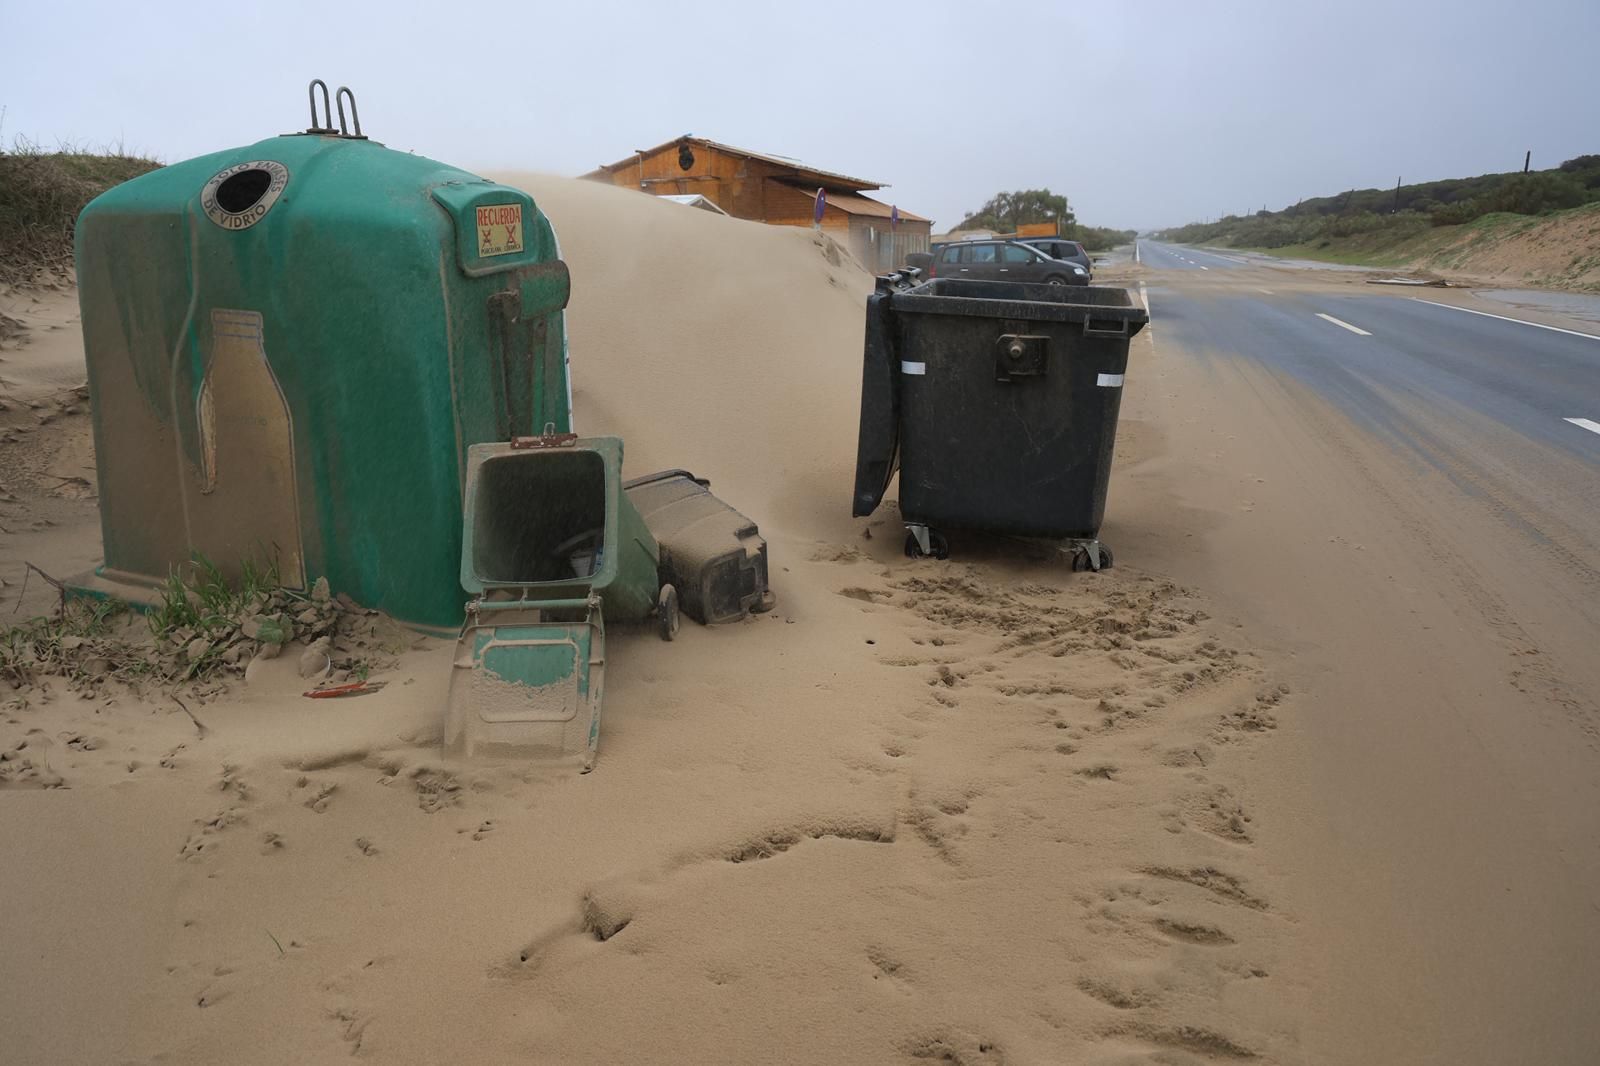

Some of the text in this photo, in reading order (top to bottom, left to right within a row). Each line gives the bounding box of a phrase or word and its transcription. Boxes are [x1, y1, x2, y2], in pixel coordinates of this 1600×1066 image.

[210, 163, 249, 186] SOLO
[204, 199, 266, 228] DE VIDRIO
[477, 207, 520, 226] RECUERDA
